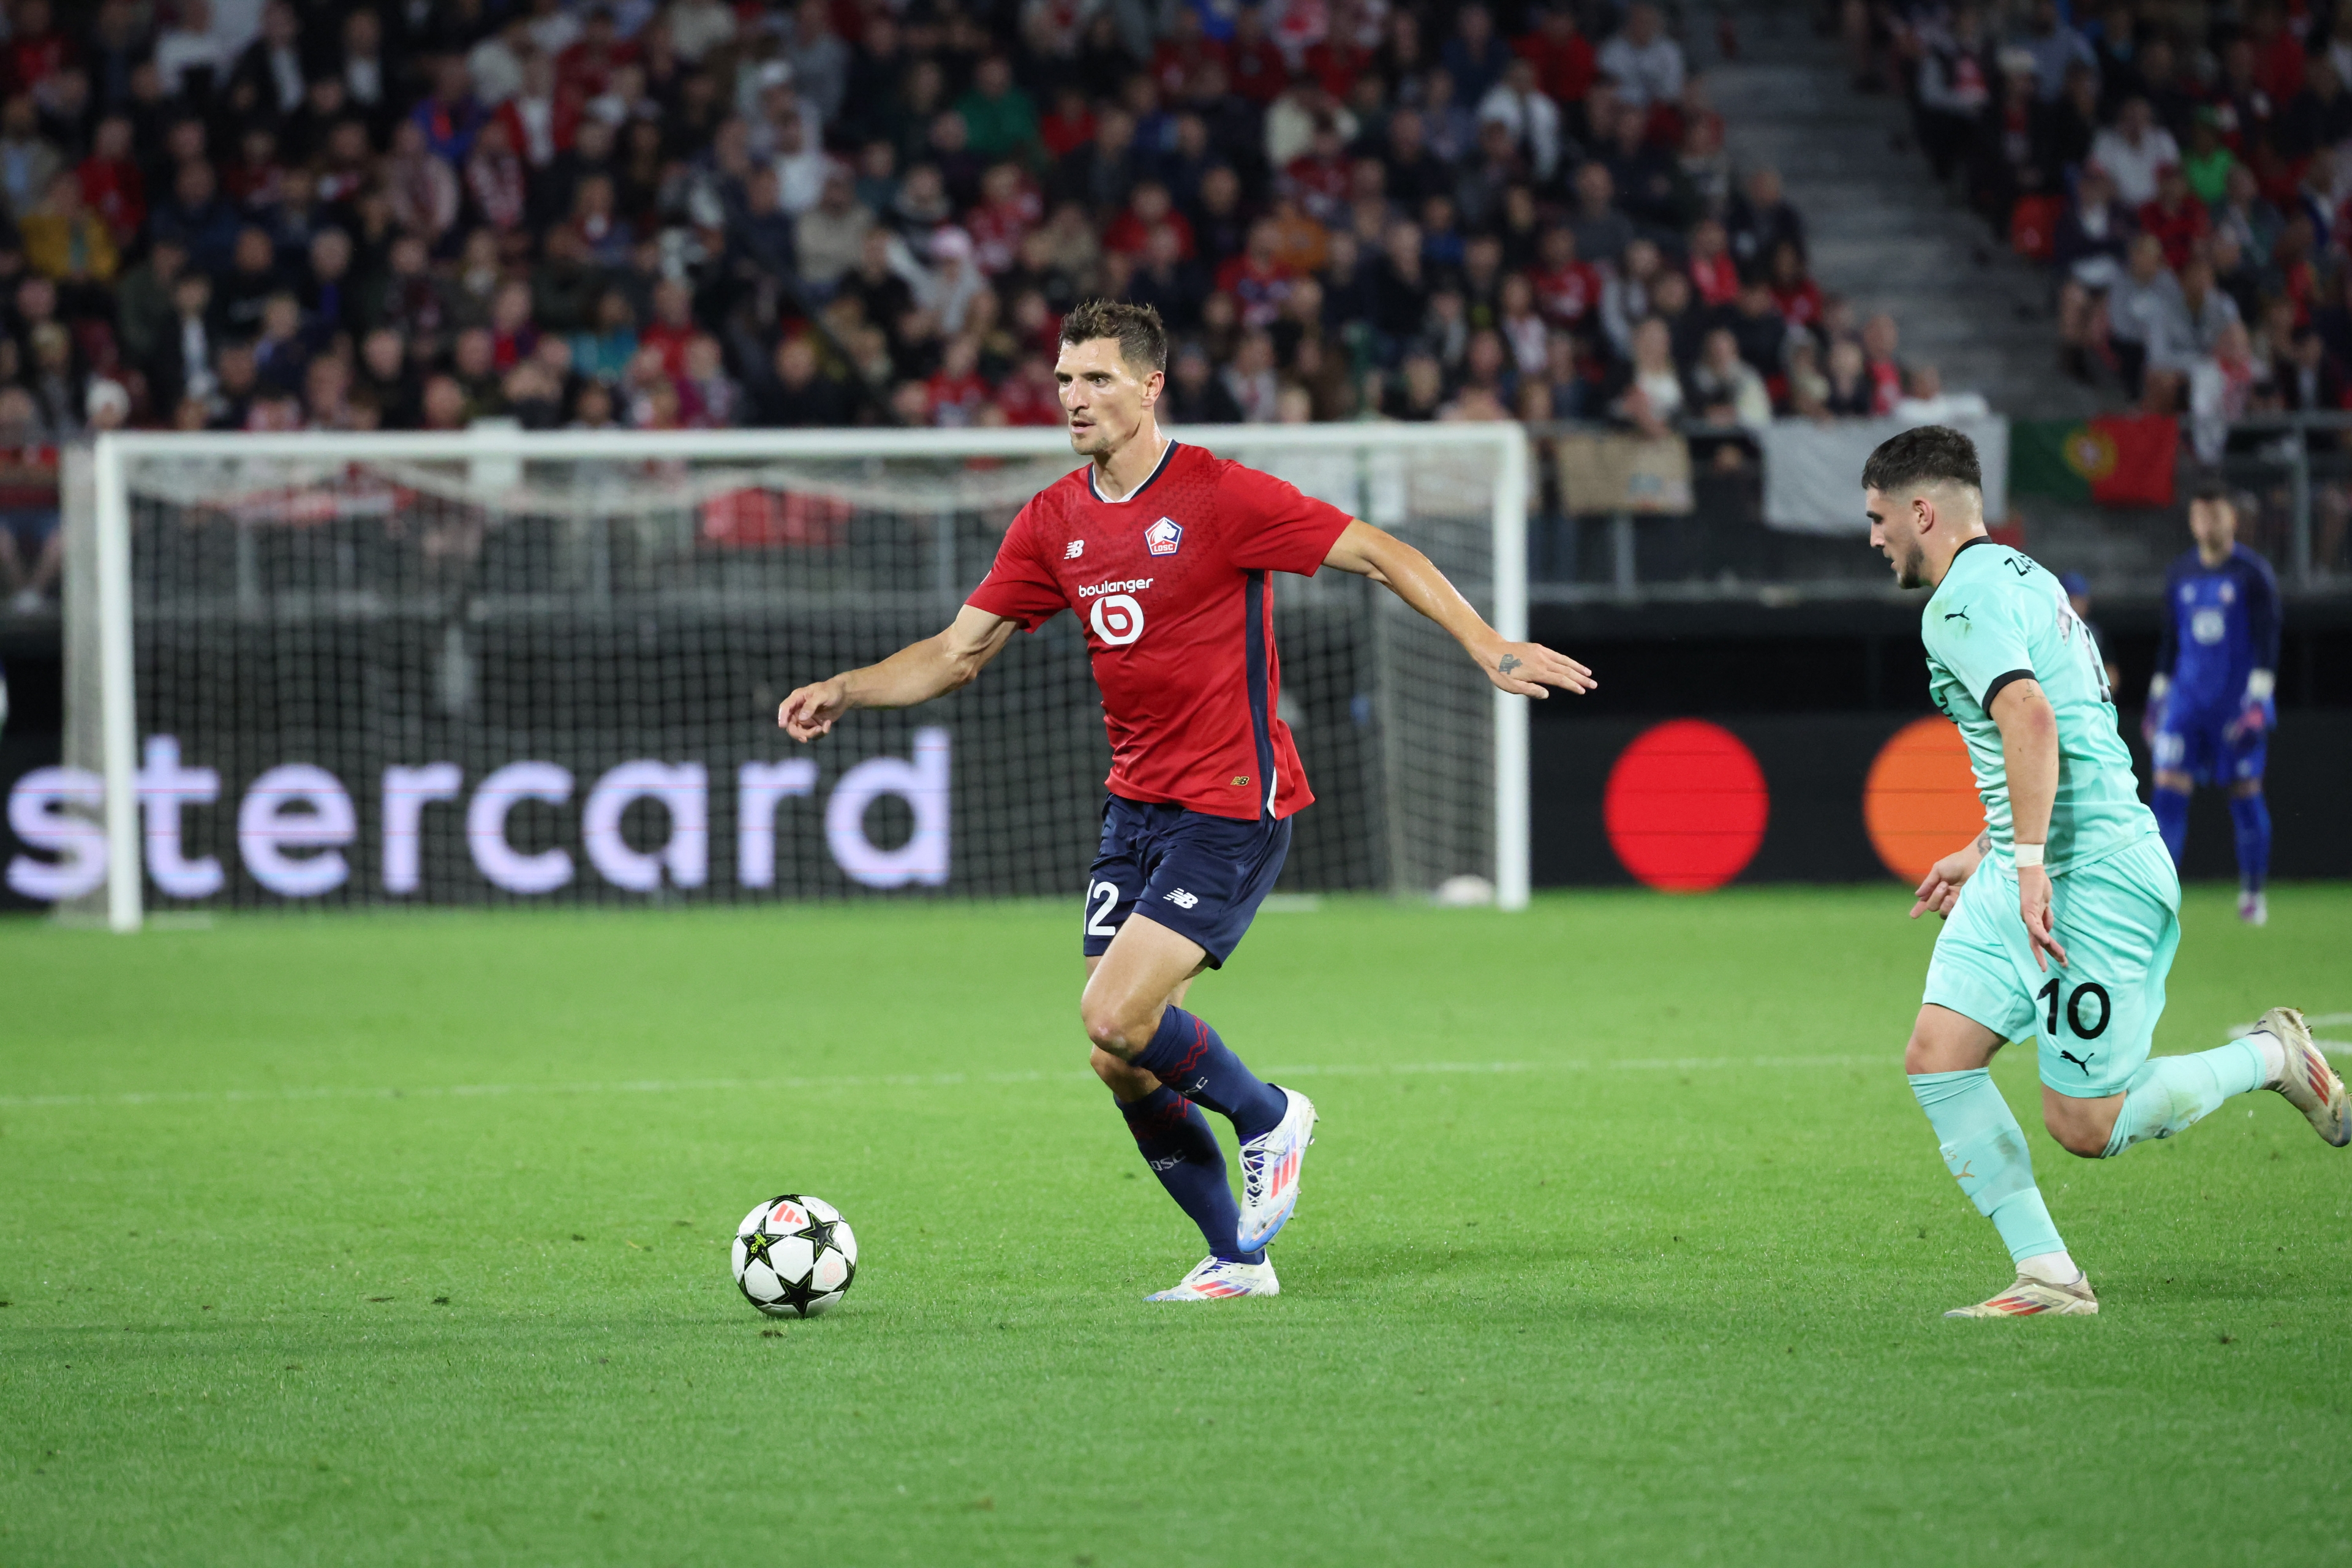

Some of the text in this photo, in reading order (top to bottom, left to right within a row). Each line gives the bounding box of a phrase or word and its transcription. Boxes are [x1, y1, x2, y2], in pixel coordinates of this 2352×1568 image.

[1153, 543, 1174, 552] LOSC
[1079, 578, 1153, 598] boulanger
[5, 725, 952, 899] stercard
[2035, 978, 2111, 1040] 10
